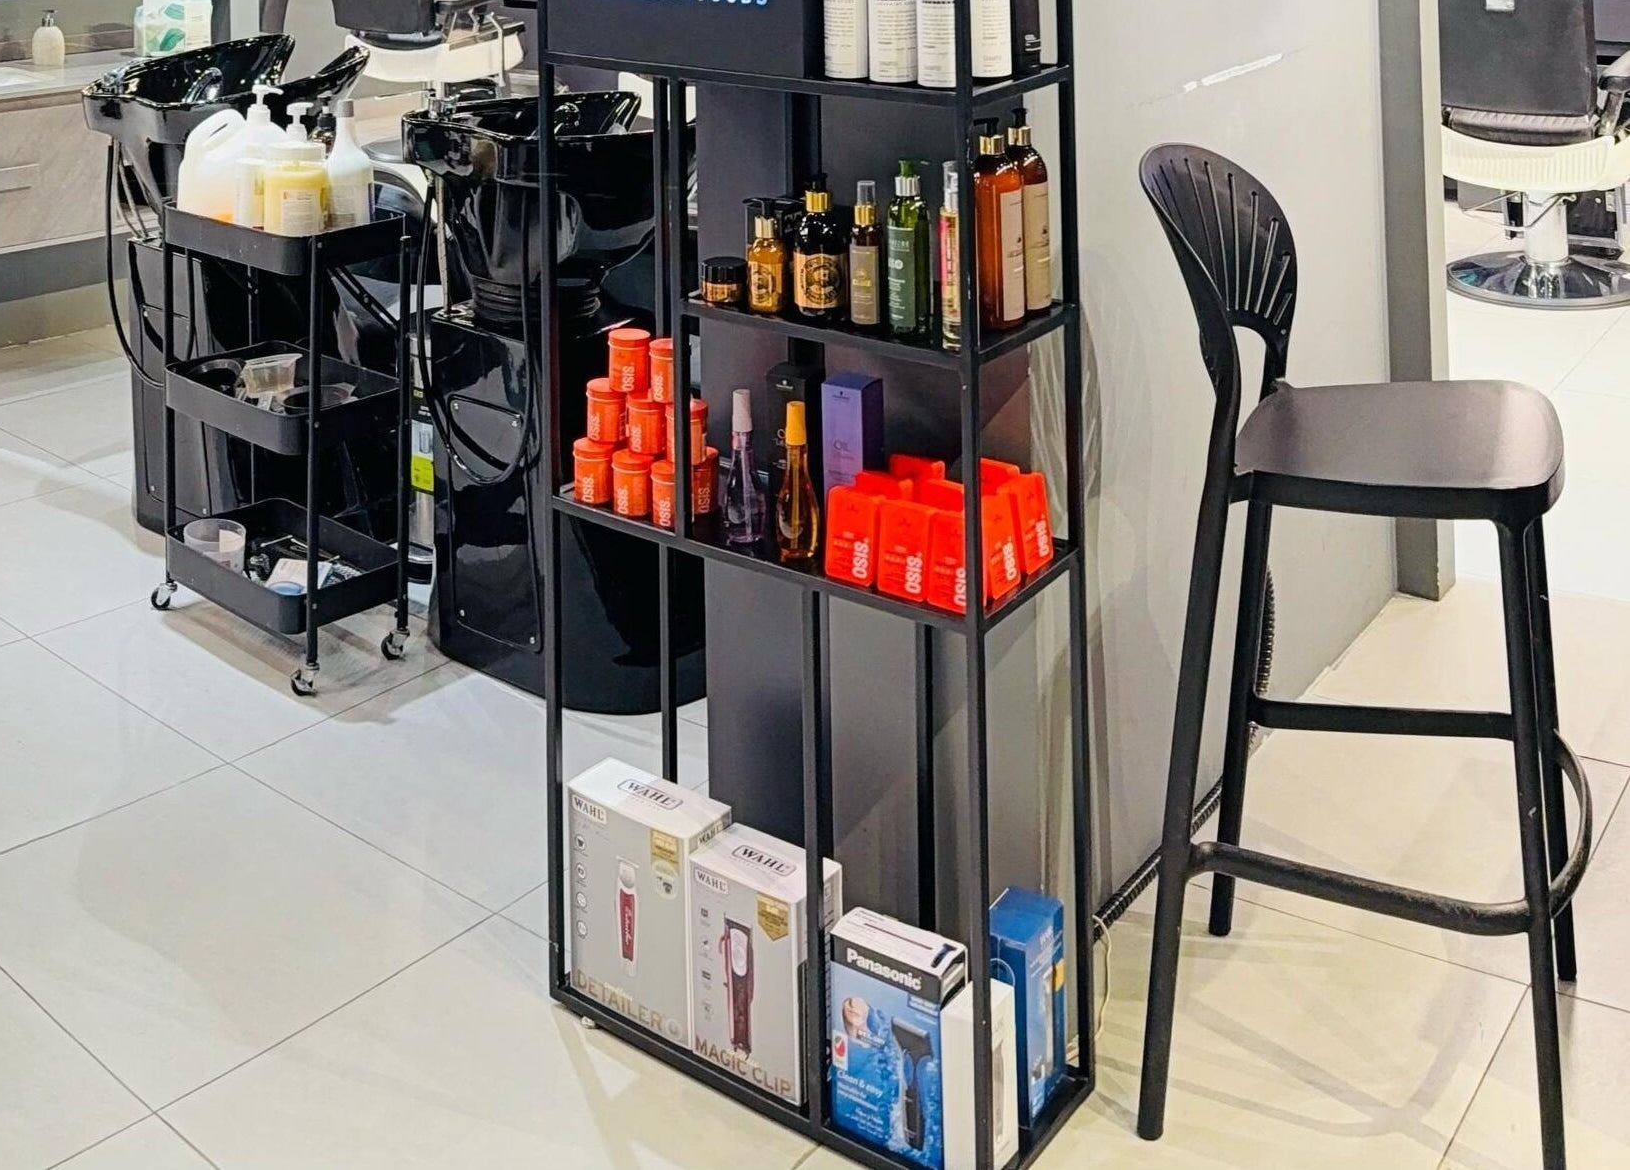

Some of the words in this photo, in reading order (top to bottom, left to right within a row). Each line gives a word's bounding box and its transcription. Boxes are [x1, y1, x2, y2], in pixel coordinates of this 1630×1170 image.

[627, 782, 678, 806] WAHL
[573, 796, 605, 821] WAHL
[742, 848, 790, 873] WAHL
[697, 870, 727, 892] WAHL
[846, 947, 922, 991] Panasonic
[576, 969, 663, 1031] DETAILER
[695, 1035, 747, 1076] MAGIC
[752, 1066, 792, 1095] CLIP
